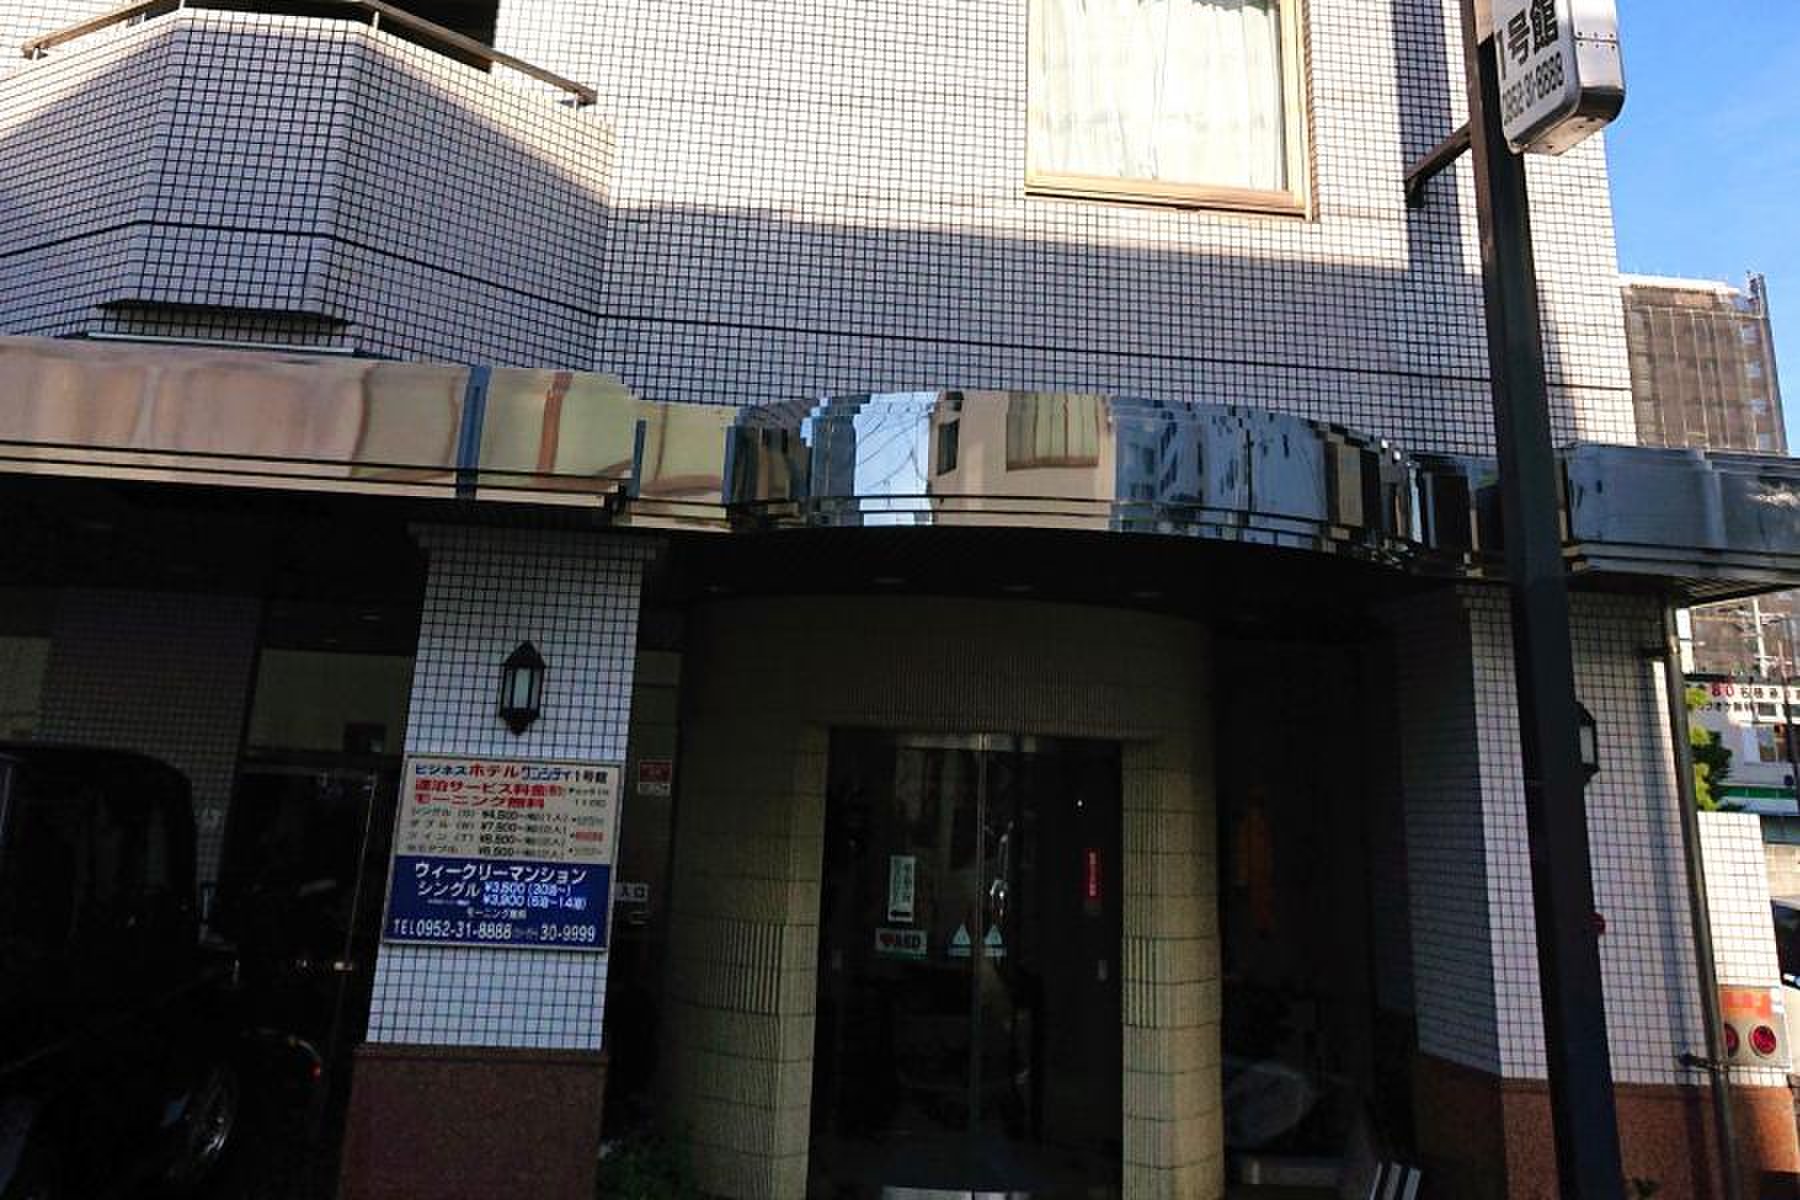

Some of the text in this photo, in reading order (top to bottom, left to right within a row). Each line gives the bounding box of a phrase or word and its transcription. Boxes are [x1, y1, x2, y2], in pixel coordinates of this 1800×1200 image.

[415, 863, 587, 884] ウィークリーマンション
[417, 880, 480, 898] シングル
